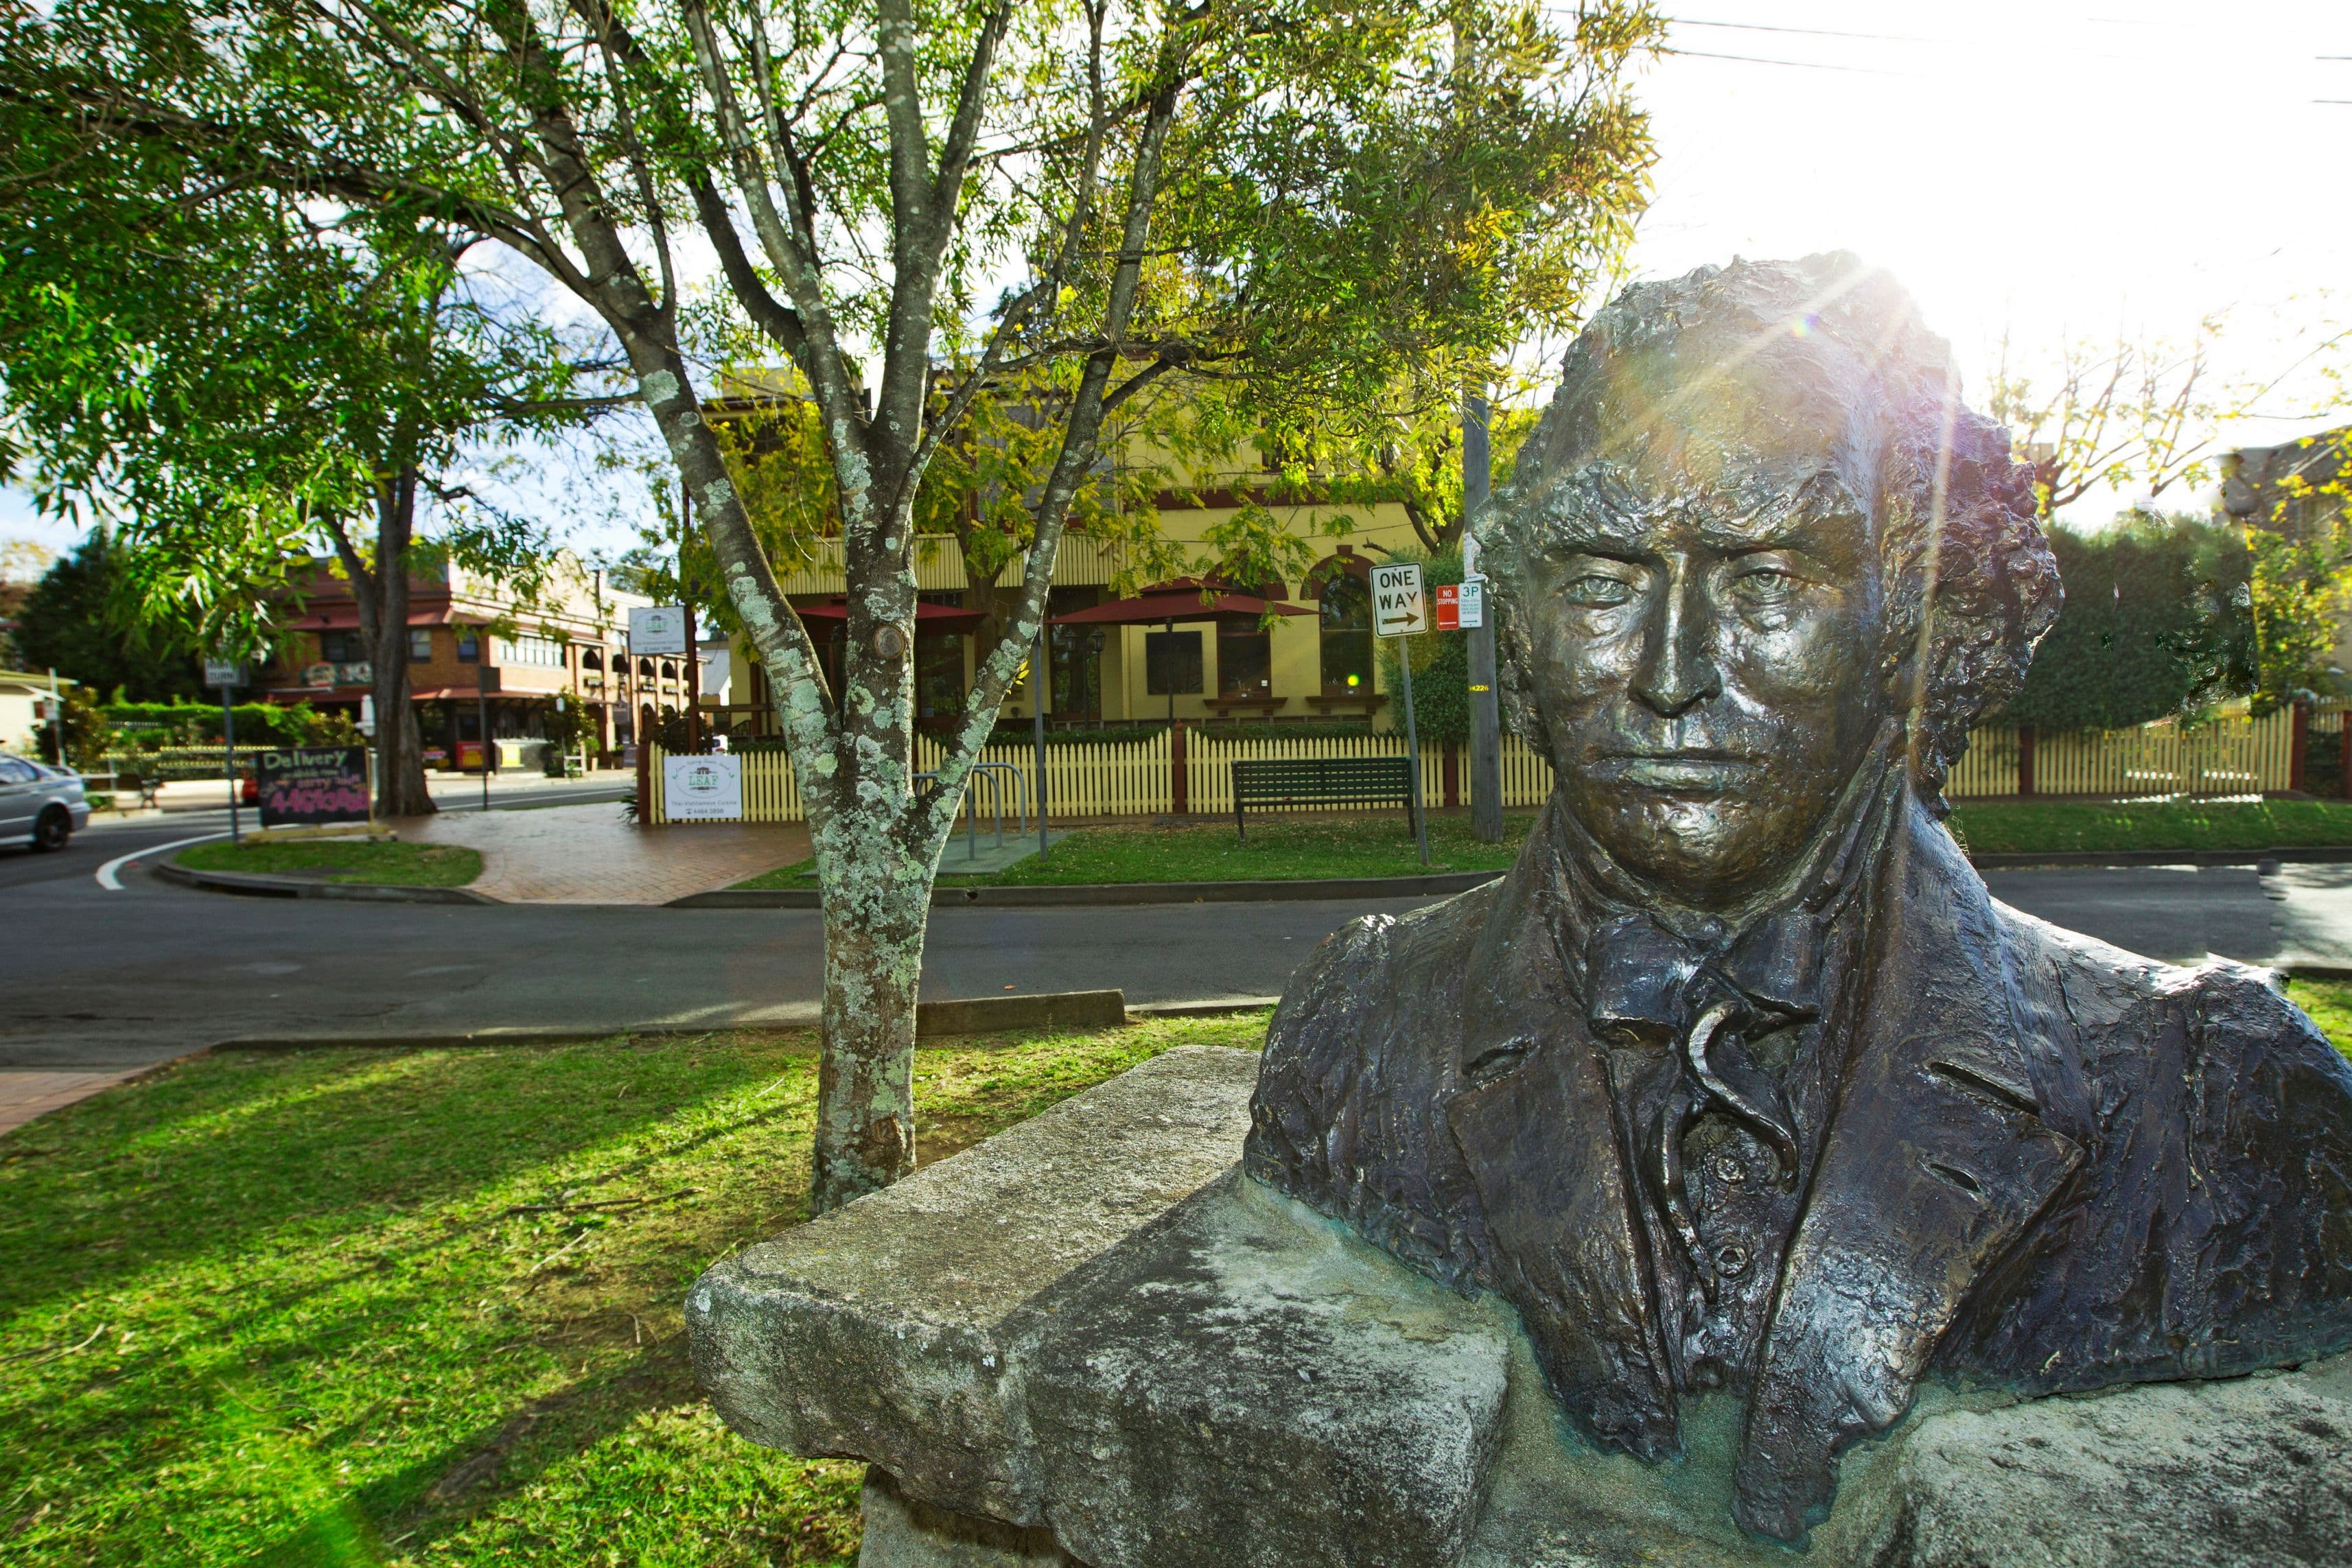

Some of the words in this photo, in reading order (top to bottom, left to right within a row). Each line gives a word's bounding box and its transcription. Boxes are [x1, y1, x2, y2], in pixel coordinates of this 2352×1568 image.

[1379, 570, 1414, 588] ONE
[1443, 589, 1452, 598] NO
[1463, 587, 1478, 597] 3P
[1379, 592, 1417, 610] WAY
[264, 750, 347, 769] Delivery
[688, 775, 719, 786] LEAF
